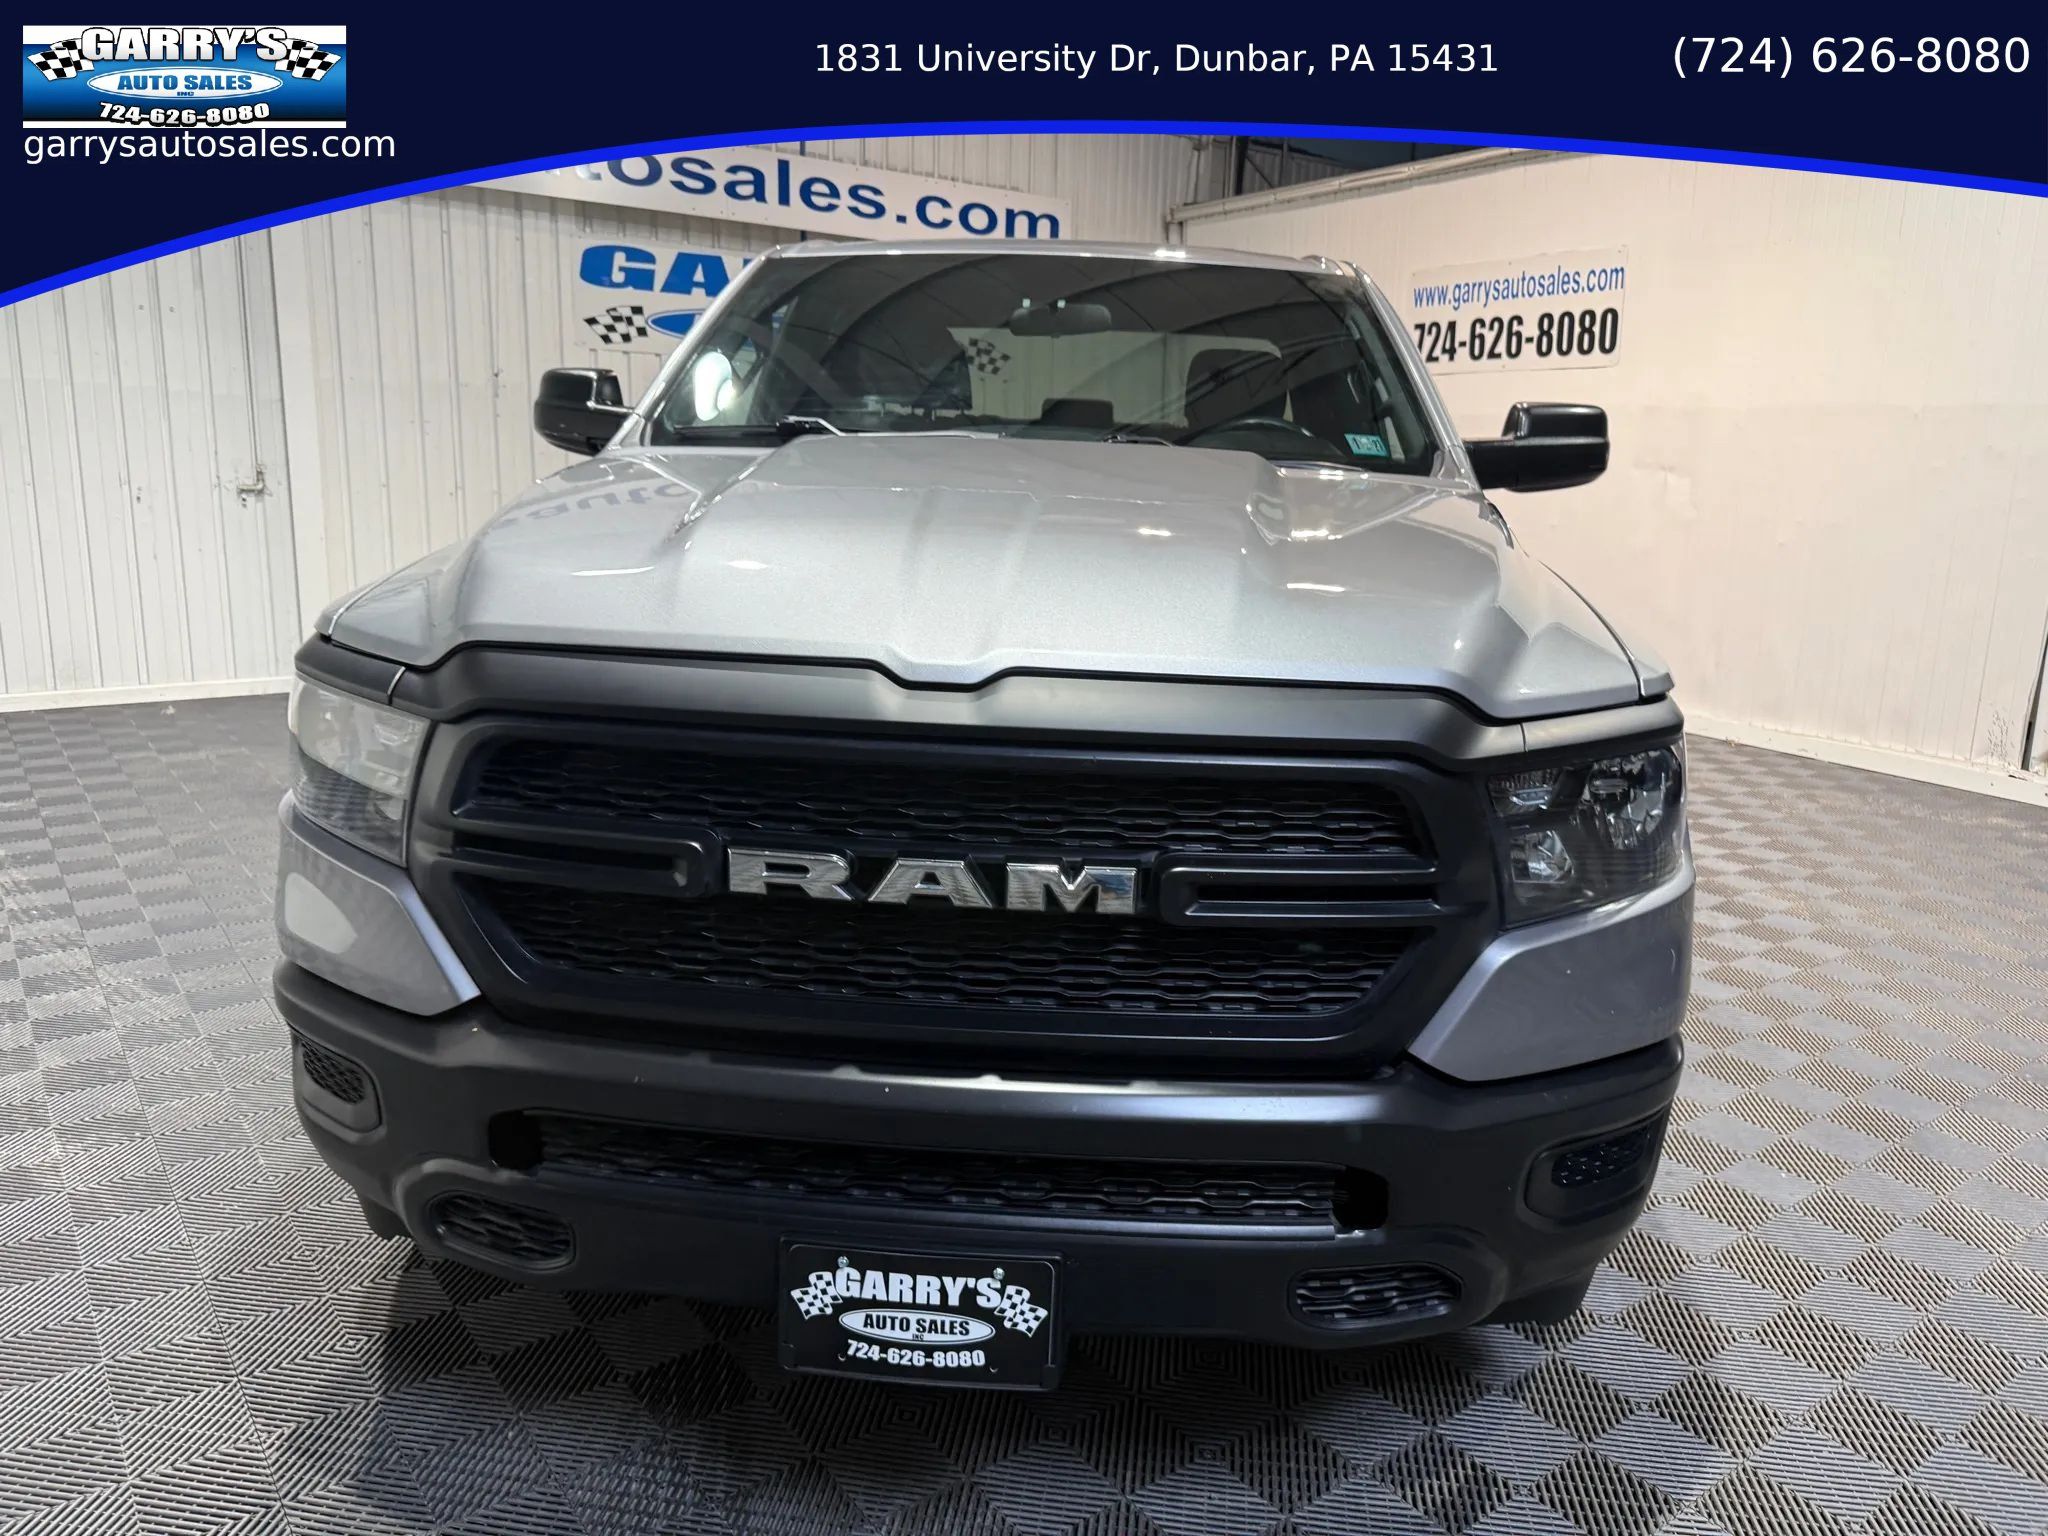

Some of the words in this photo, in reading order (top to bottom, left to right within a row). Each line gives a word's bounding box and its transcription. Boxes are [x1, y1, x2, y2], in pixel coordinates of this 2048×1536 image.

[579, 244, 752, 298] GA
[1413, 265, 1625, 311] www.garrysautosales.com
[1414, 307, 1619, 363] 724-626-8080
[728, 848, 1137, 914] RAM
[835, 1266, 1002, 1309] GARRY'S
[863, 1313, 911, 1334] AUTO
[916, 1317, 970, 1336] SALES
[847, 1339, 986, 1368] 724-626-8080
